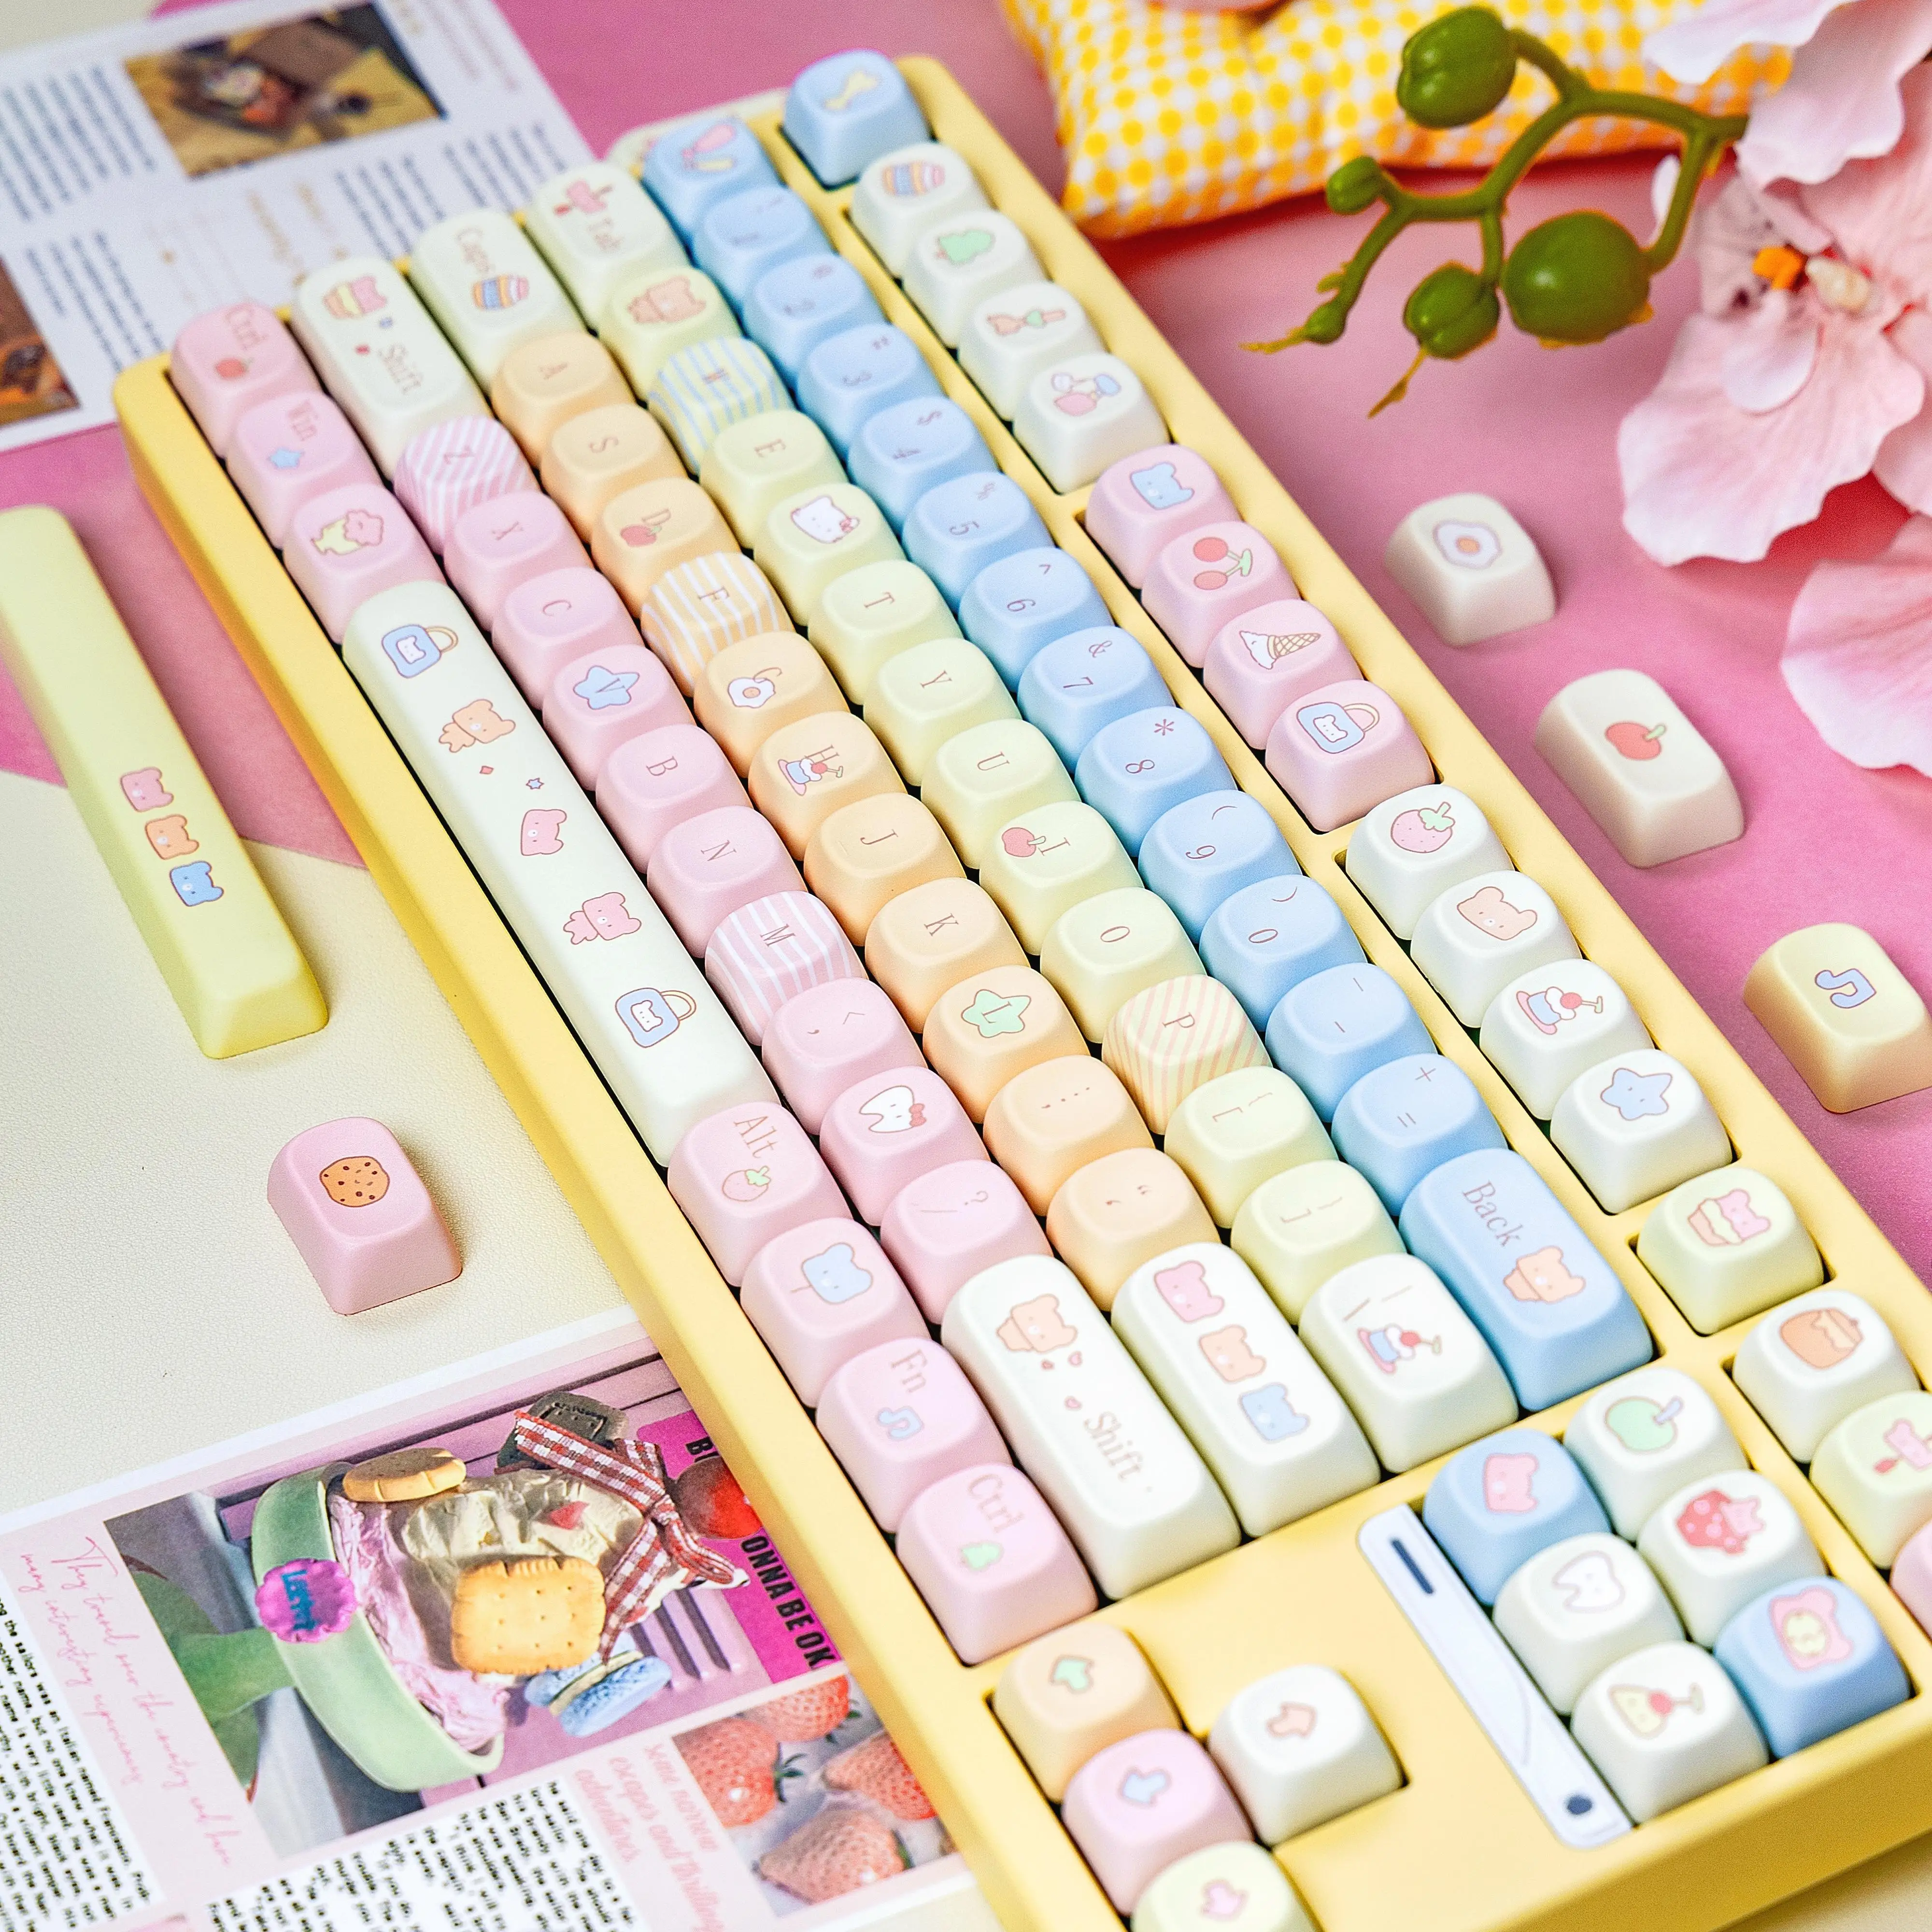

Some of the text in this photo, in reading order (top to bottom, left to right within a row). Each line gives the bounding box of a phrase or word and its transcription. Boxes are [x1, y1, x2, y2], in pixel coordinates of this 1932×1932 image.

[588, 436, 619, 454] S
[754, 438, 786, 457] E
[641, 508, 672, 526] D
[491, 521, 524, 540] X
[697, 587, 730, 600] F
[864, 591, 895, 609] T
[542, 599, 572, 617] C
[1007, 597, 1036, 612] 6
[595, 678, 628, 693] V
[920, 670, 952, 688] Y
[1063, 676, 1094, 689] 7
[646, 756, 678, 777] B
[977, 751, 1010, 771] U
[1125, 759, 1155, 774] 8
[860, 829, 898, 845] J
[700, 839, 737, 862] N
[1185, 845, 1216, 860] 9
[923, 913, 959, 937] K
[1100, 925, 1130, 943] O
[760, 923, 796, 947] M
[980, 1001, 1012, 1024] L
[1162, 1012, 1195, 1029] P
[733, 1113, 778, 1159] Alt
[1461, 1180, 1524, 1248] Back
[890, 1349, 928, 1393] Fn
[1083, 1411, 1145, 1480] Shift
[966, 1473, 1026, 1534] Ctrl
[18, 1552, 47, 1593] many
[51, 1536, 118, 1590] They
[83, 1593, 140, 1646] travel
[776, 1598, 814, 1631] BE
[796, 1632, 835, 1669] OK
[14, 1642, 39, 1678] sailors
